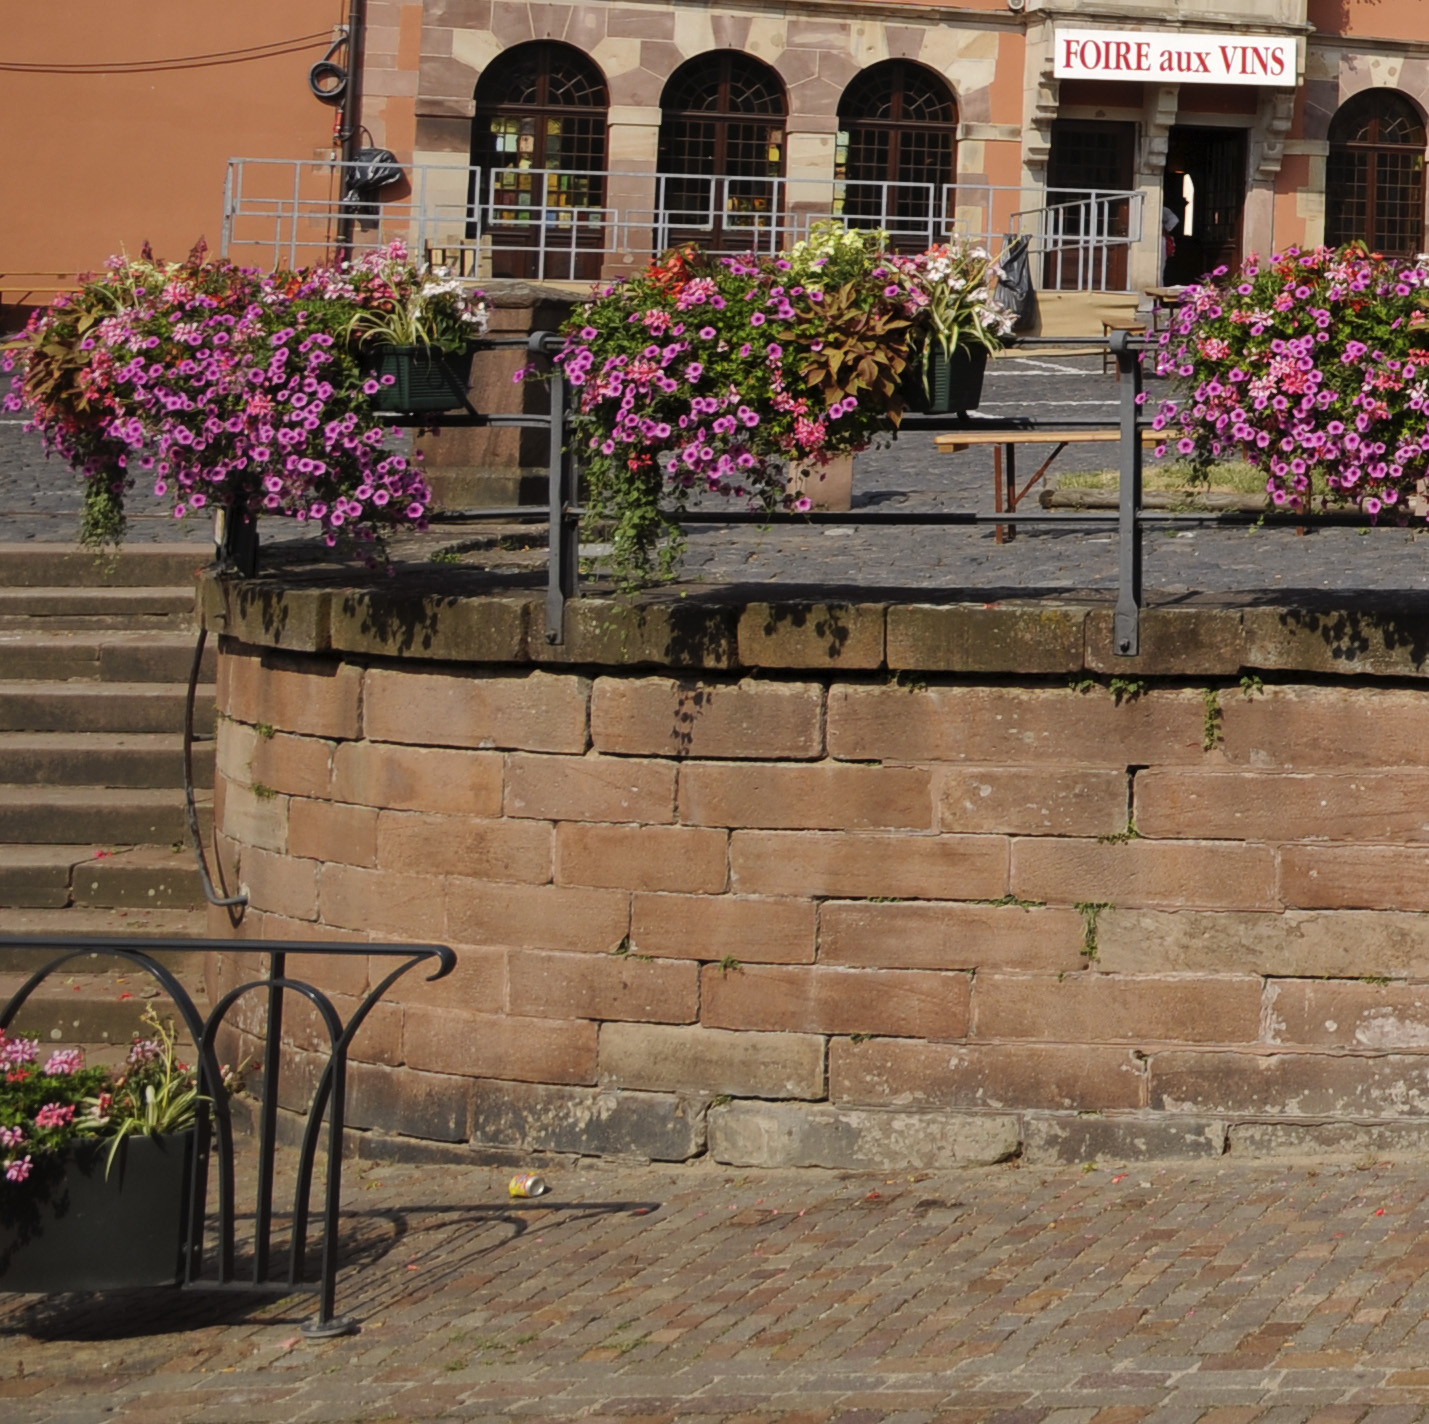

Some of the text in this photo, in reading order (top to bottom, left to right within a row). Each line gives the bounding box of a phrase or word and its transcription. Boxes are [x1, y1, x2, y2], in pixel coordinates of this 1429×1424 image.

[1062, 38, 1286, 76] FOIRE aux VINS
